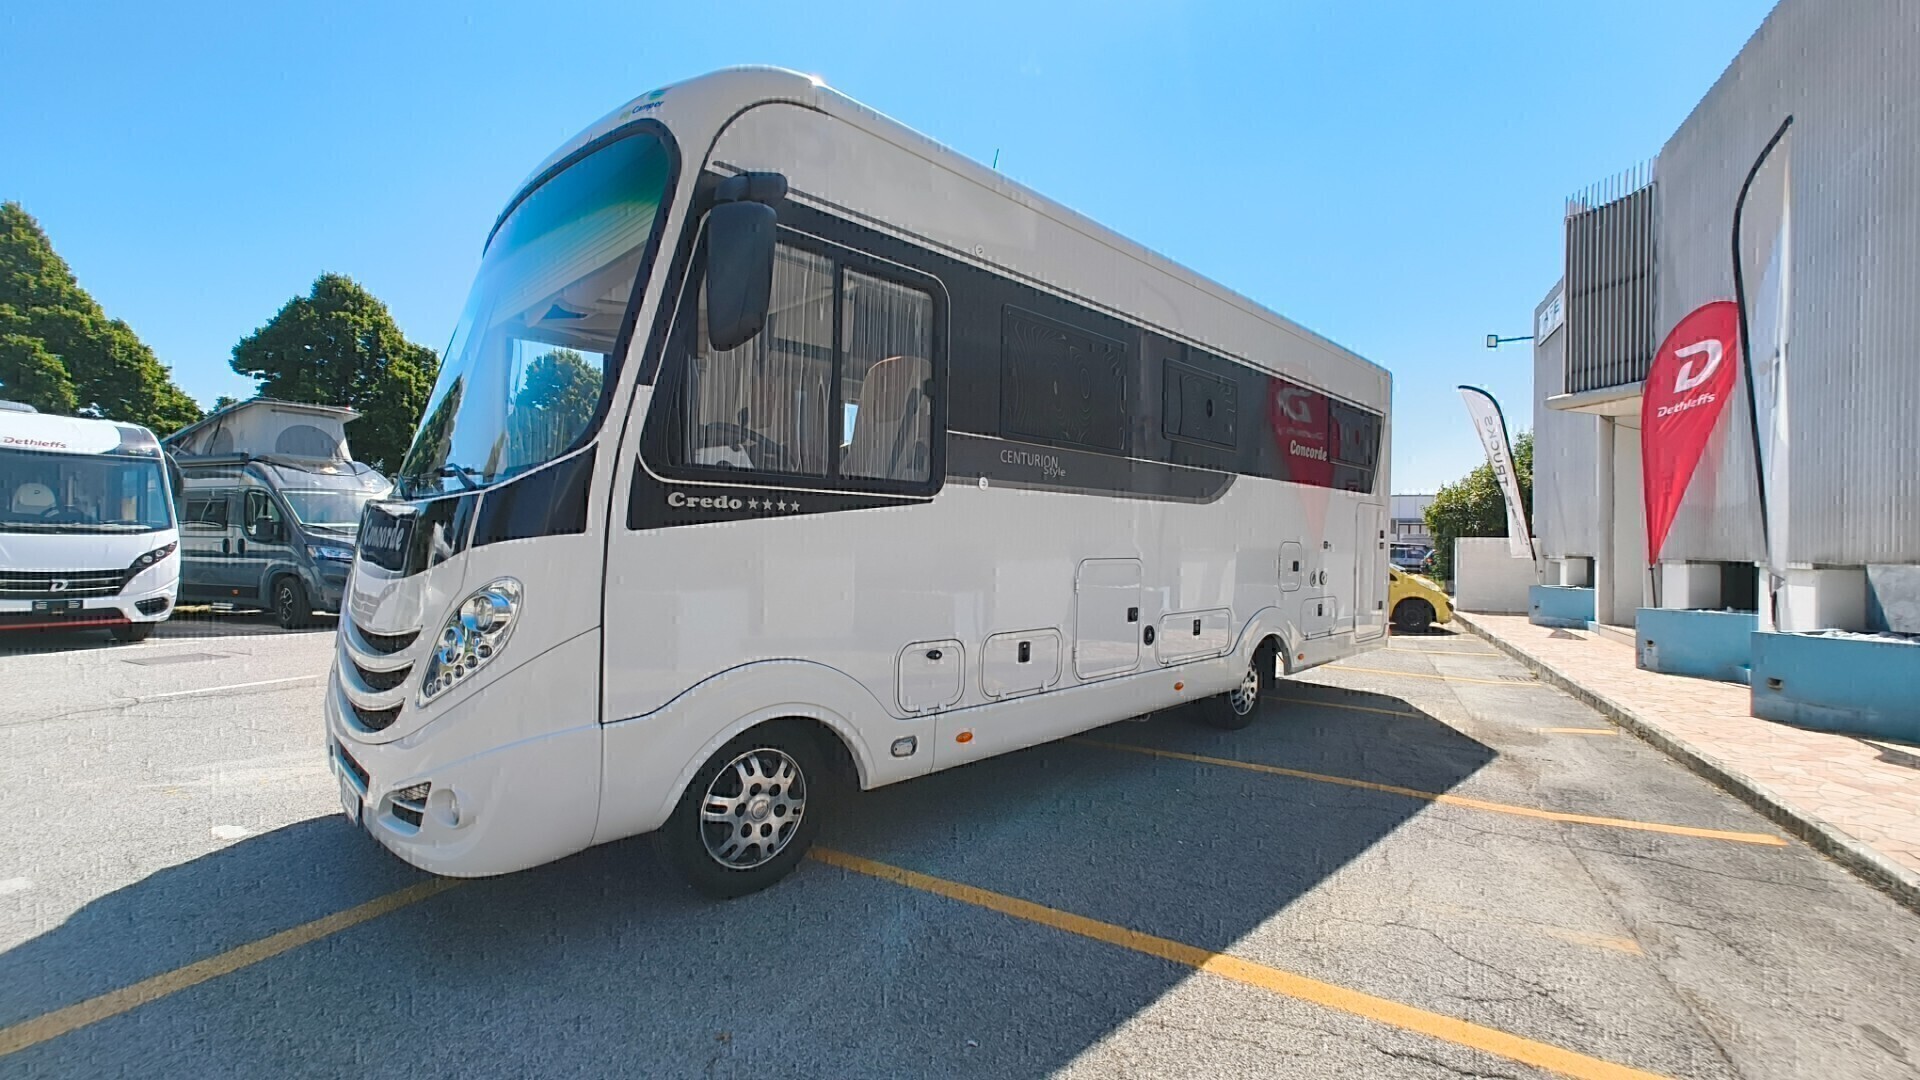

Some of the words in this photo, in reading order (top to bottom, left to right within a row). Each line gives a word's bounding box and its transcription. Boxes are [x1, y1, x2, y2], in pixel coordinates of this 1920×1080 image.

[1657, 393, 1715, 418] Dethleffs
[3, 436, 67, 449] Dethleffs
[1290, 440, 1328, 461] Concorde
[1000, 450, 1058, 468] CENTURION
[1043, 466, 1066, 478] Style
[667, 492, 743, 509] Credo
